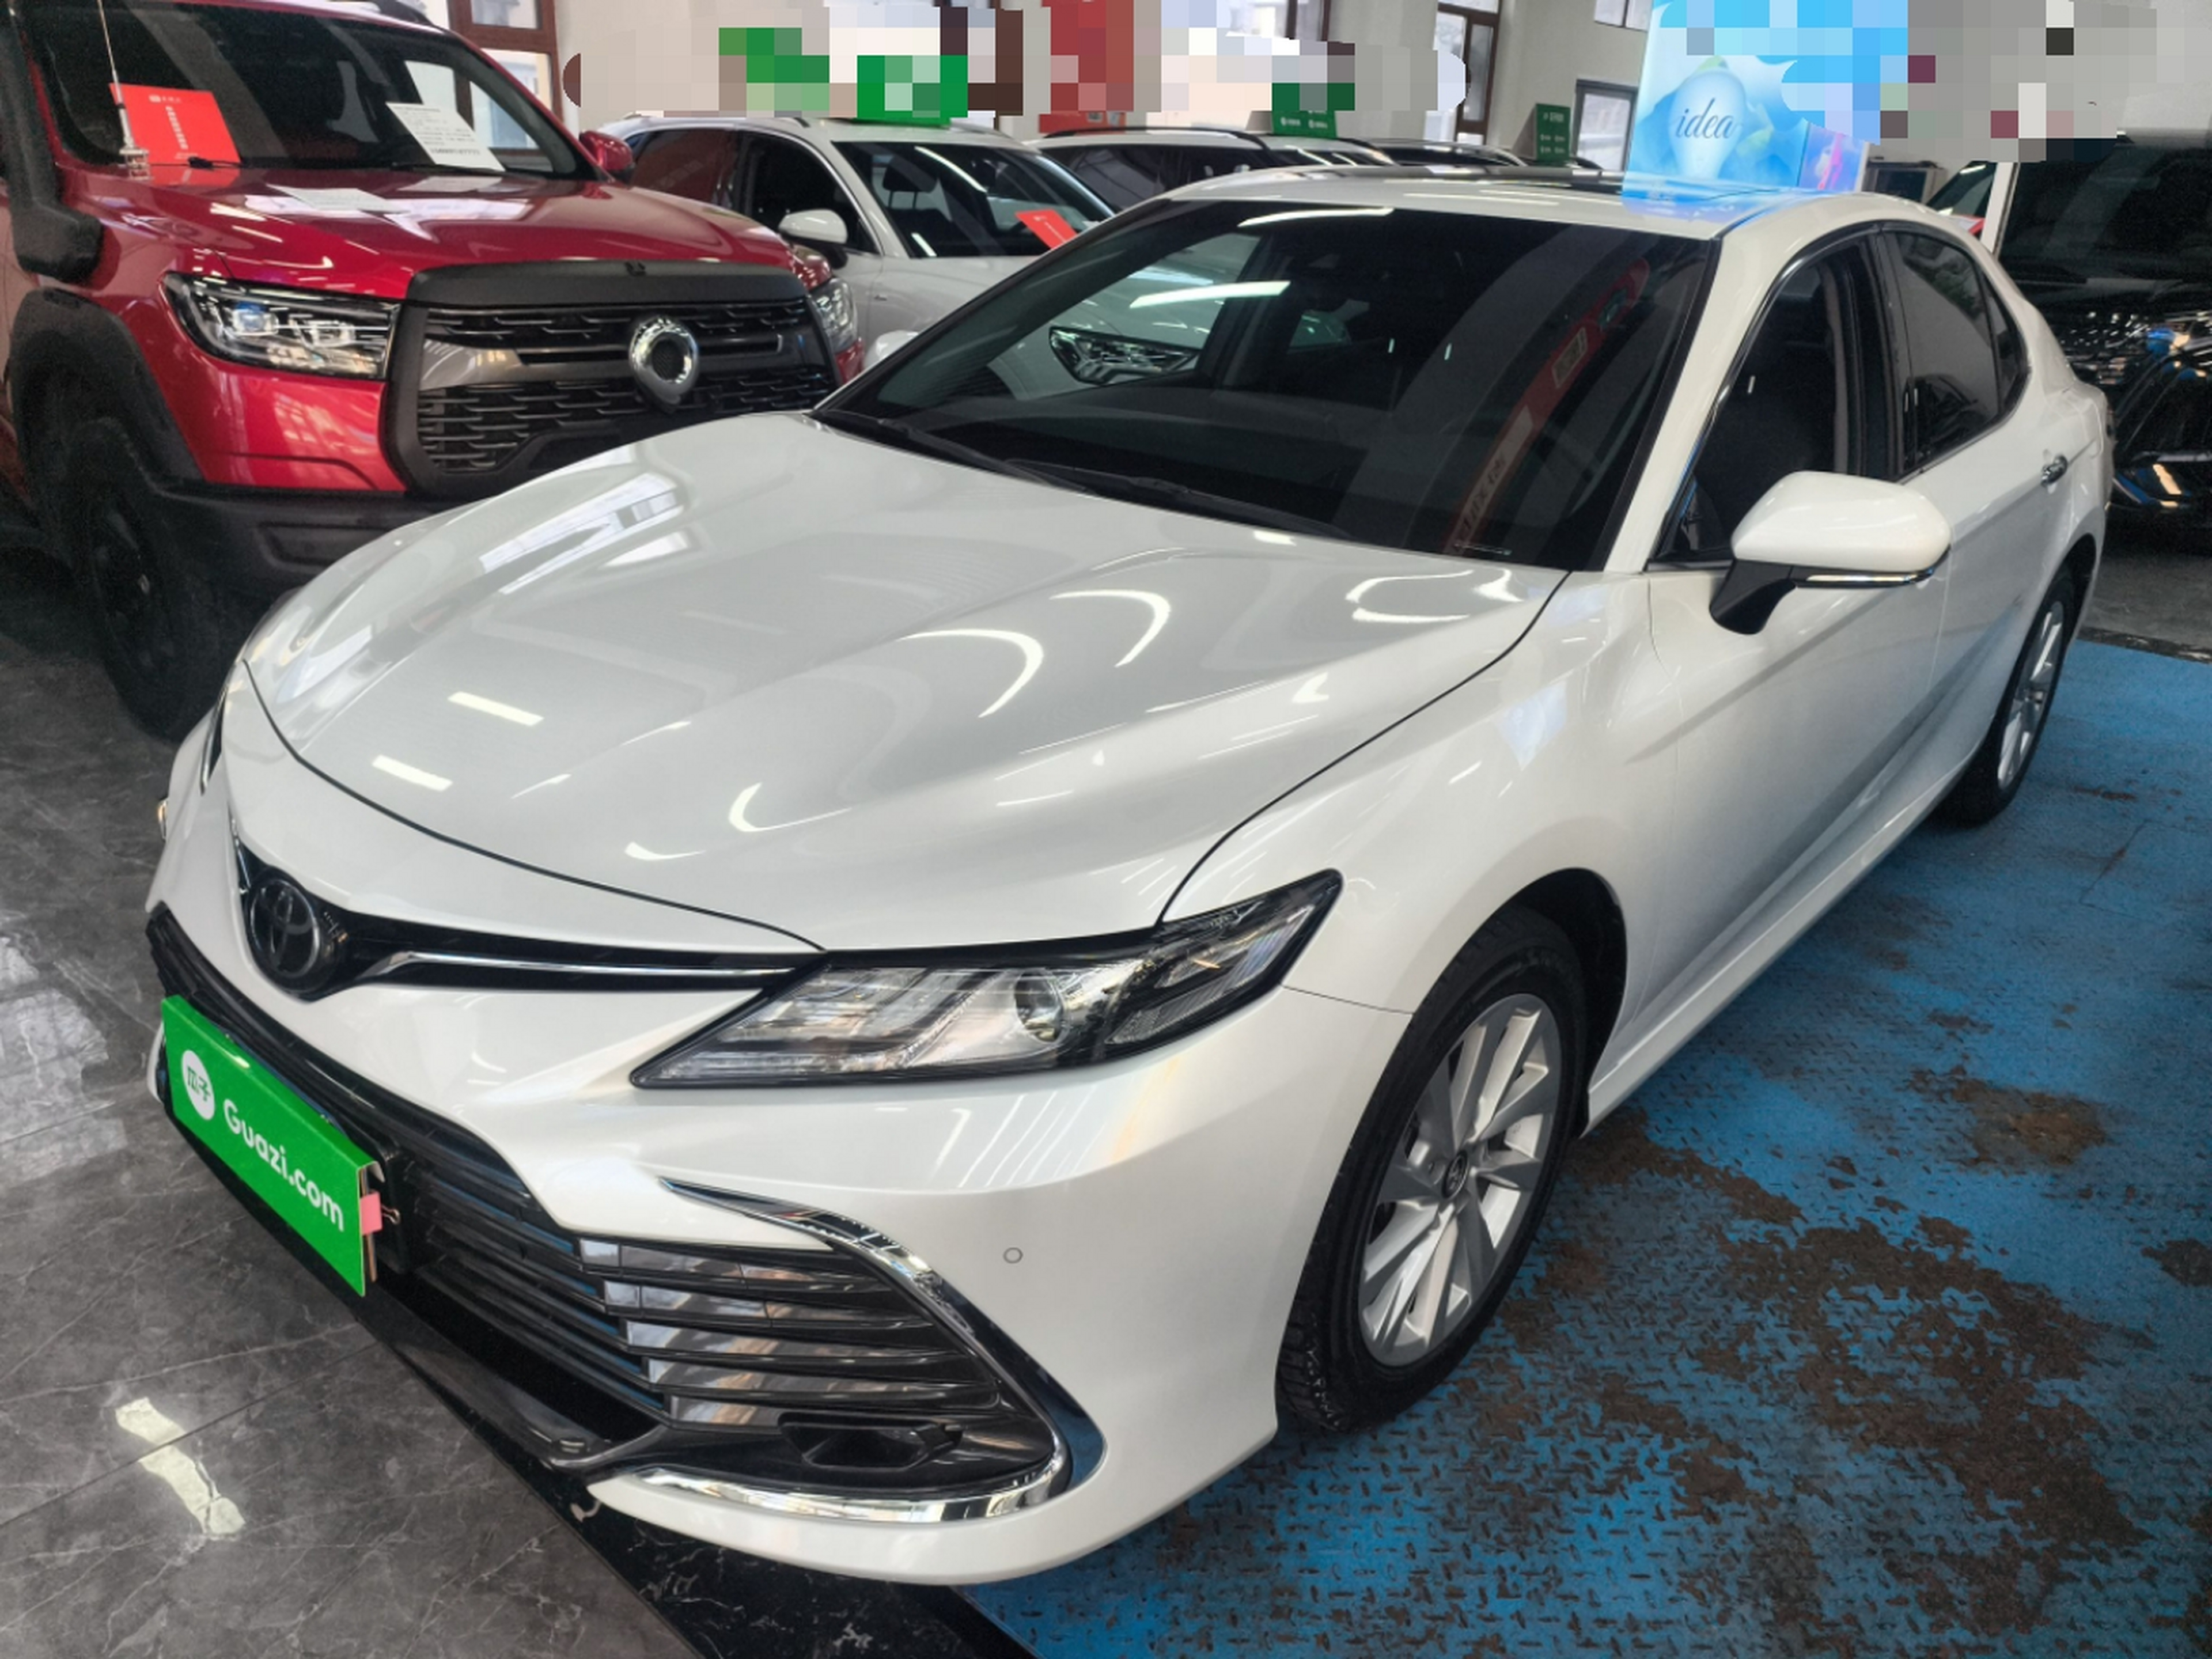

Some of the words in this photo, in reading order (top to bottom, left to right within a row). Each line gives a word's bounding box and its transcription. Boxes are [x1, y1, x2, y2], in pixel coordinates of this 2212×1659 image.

[1676, 98, 1741, 138] idea
[187, 1065, 211, 1101] 瓜子
[223, 1099, 344, 1232] Guazi.com
